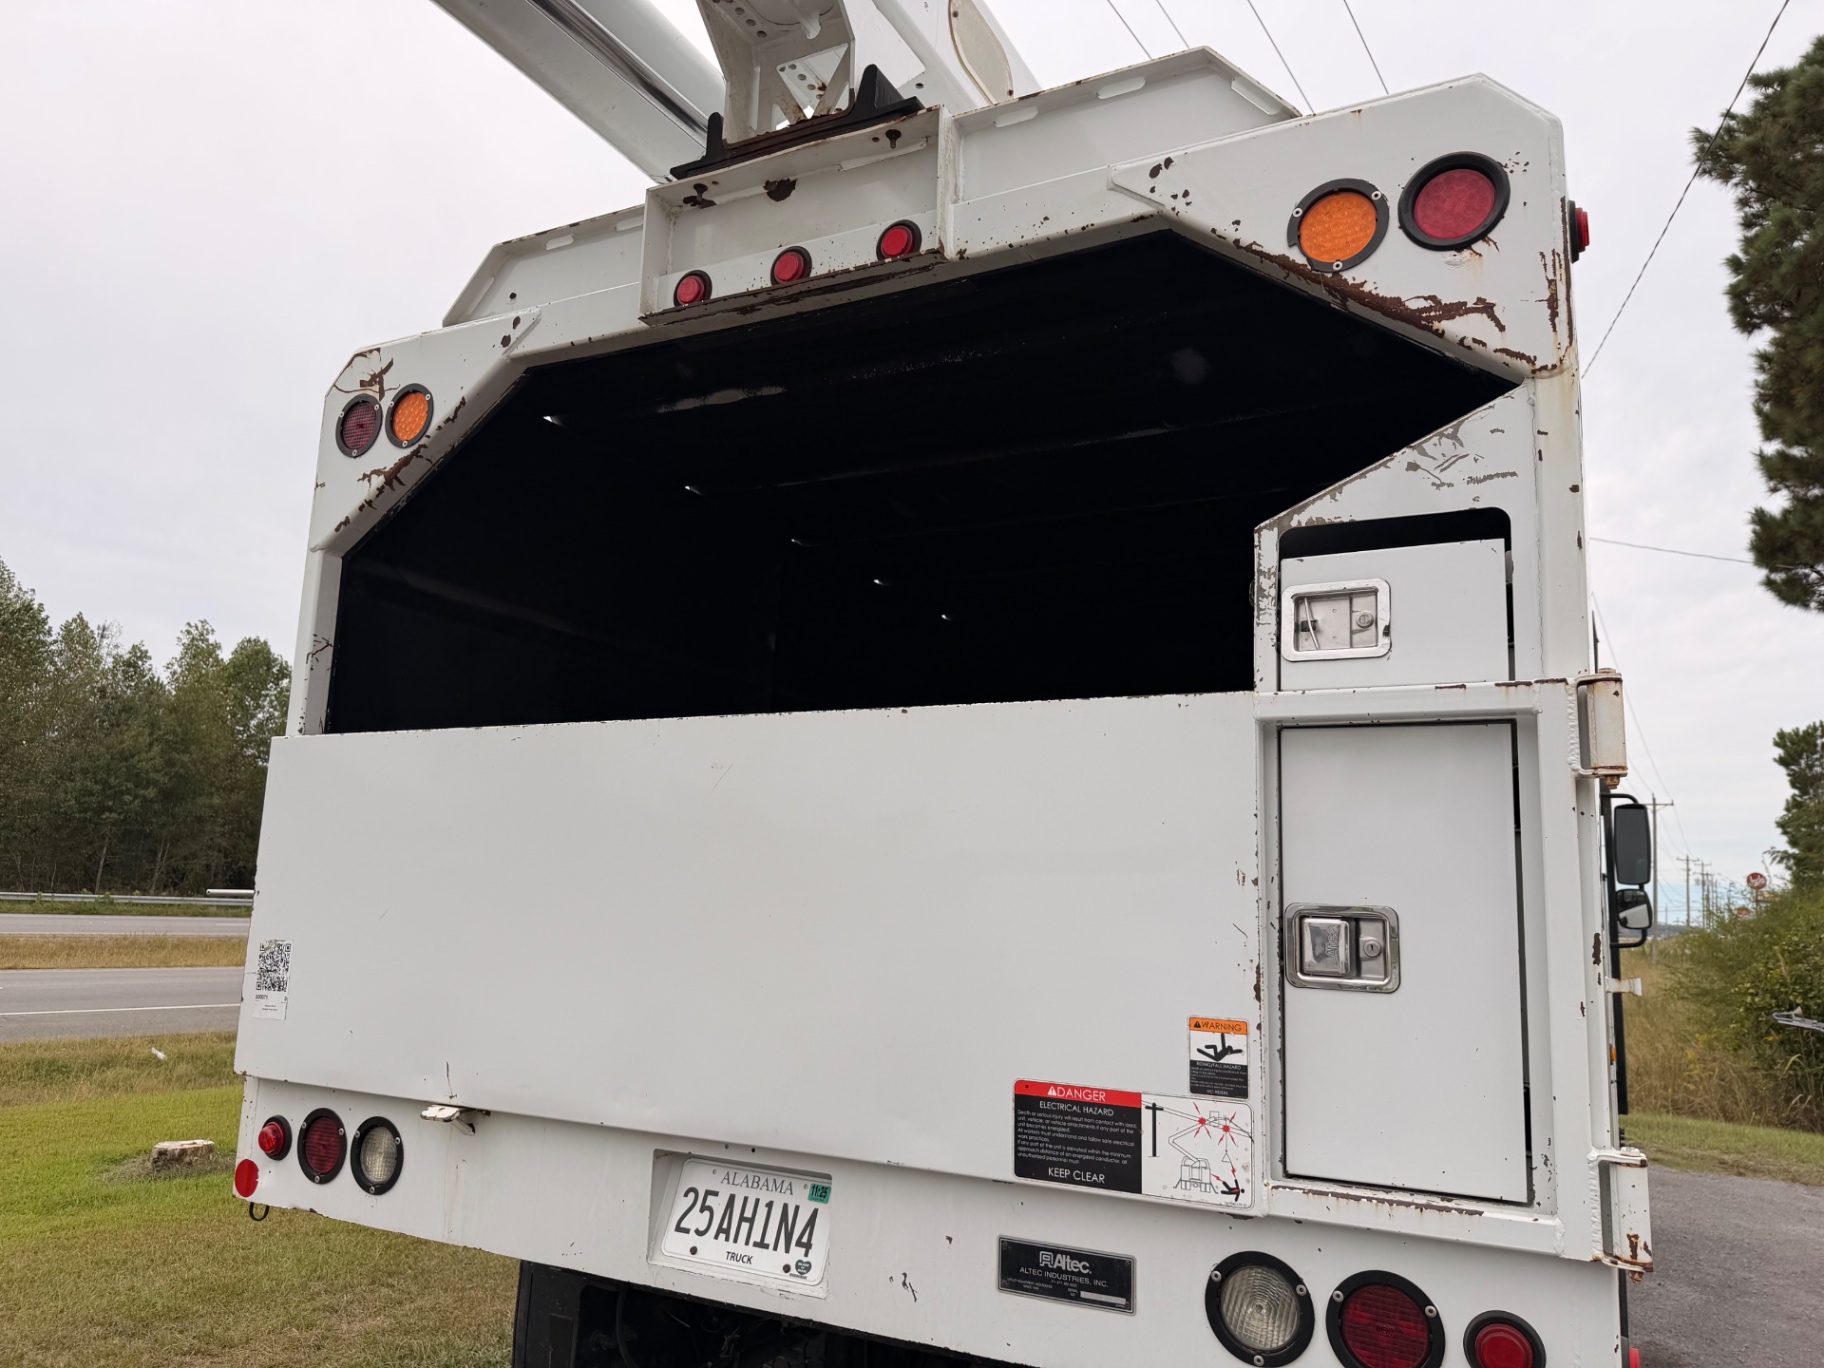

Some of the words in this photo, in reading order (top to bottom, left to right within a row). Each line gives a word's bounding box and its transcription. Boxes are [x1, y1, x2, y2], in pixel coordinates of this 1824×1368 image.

[1202, 1021, 1242, 1032] WARNING
[1057, 1086, 1106, 1102] DANGER
[1040, 1100, 1080, 1112] ELECTRICAL
[1083, 1106, 1114, 1116] HAZARD
[720, 1171, 794, 1195] ALABAMA
[1048, 1167, 1070, 1178] KEEP
[1073, 1170, 1105, 1183] CLEAR
[674, 1187, 819, 1257] 25AH1N4
[726, 1251, 753, 1264] TRUCK
[1020, 1267, 1042, 1276] ALTEC
[1045, 1272, 1091, 1285] INDUSTRIES,
